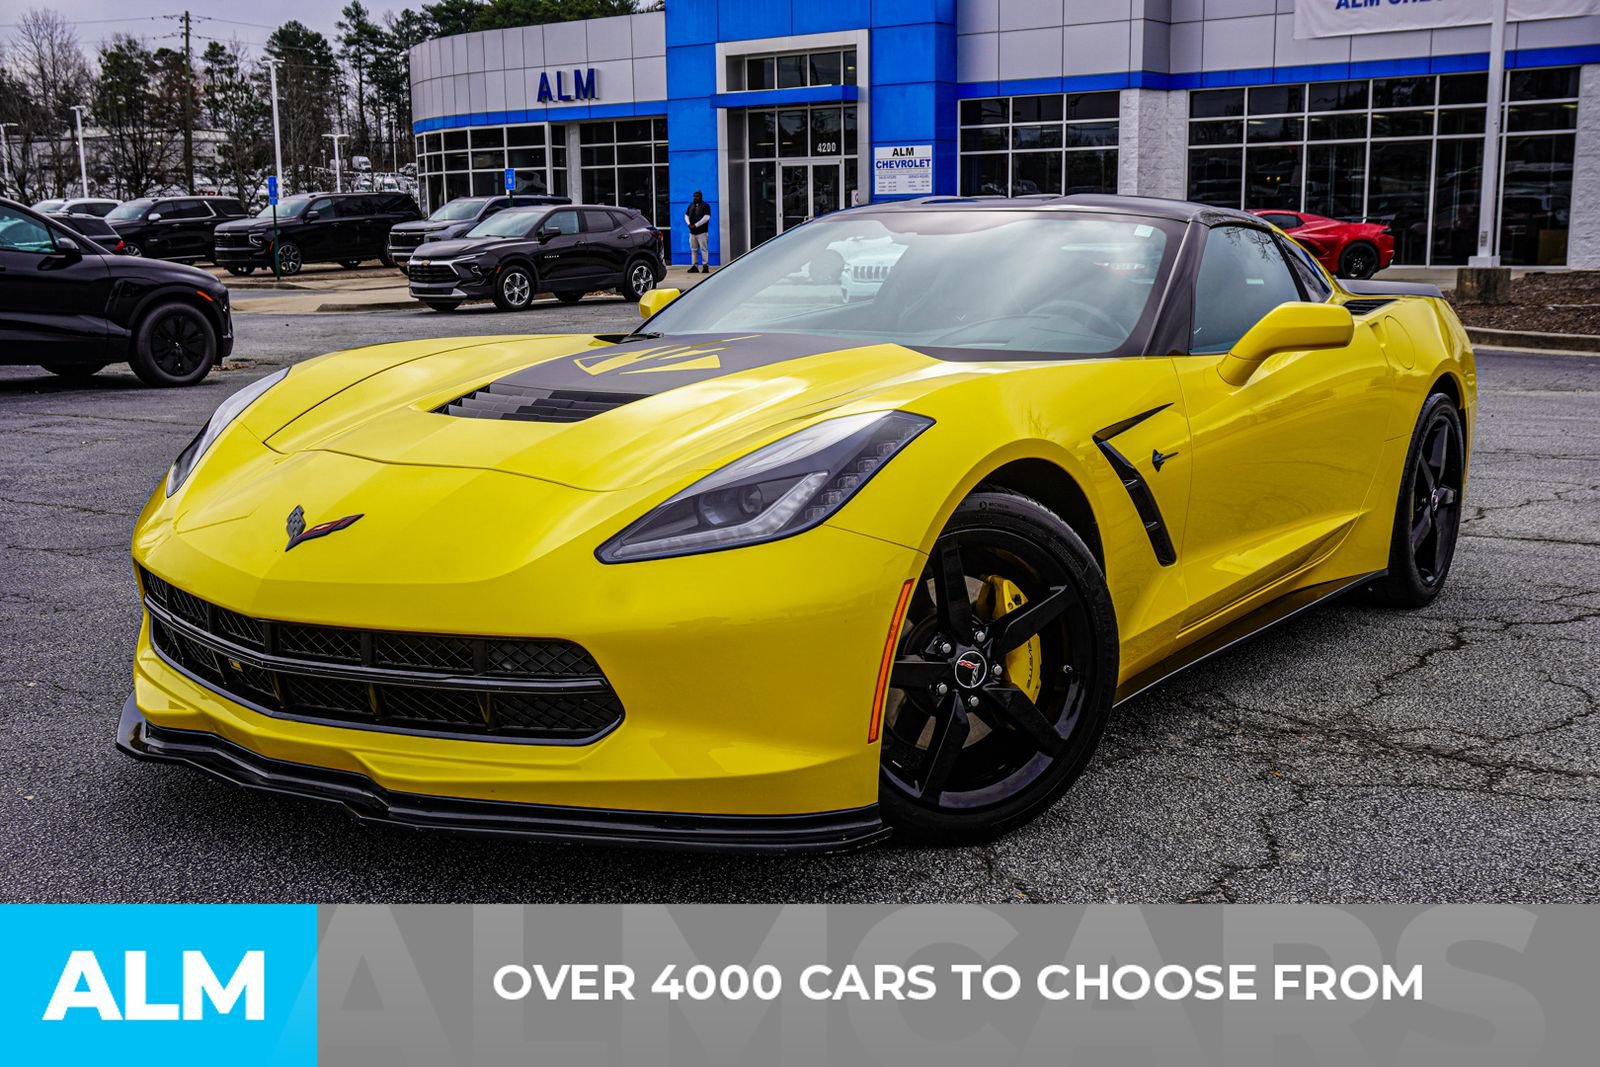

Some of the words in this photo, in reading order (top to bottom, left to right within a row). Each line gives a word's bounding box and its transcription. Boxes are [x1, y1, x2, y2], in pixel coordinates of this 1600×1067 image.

[536, 68, 597, 103] ALM
[817, 142, 836, 153] 4200
[892, 147, 914, 157] ALM
[875, 159, 931, 169] CHEVROLET
